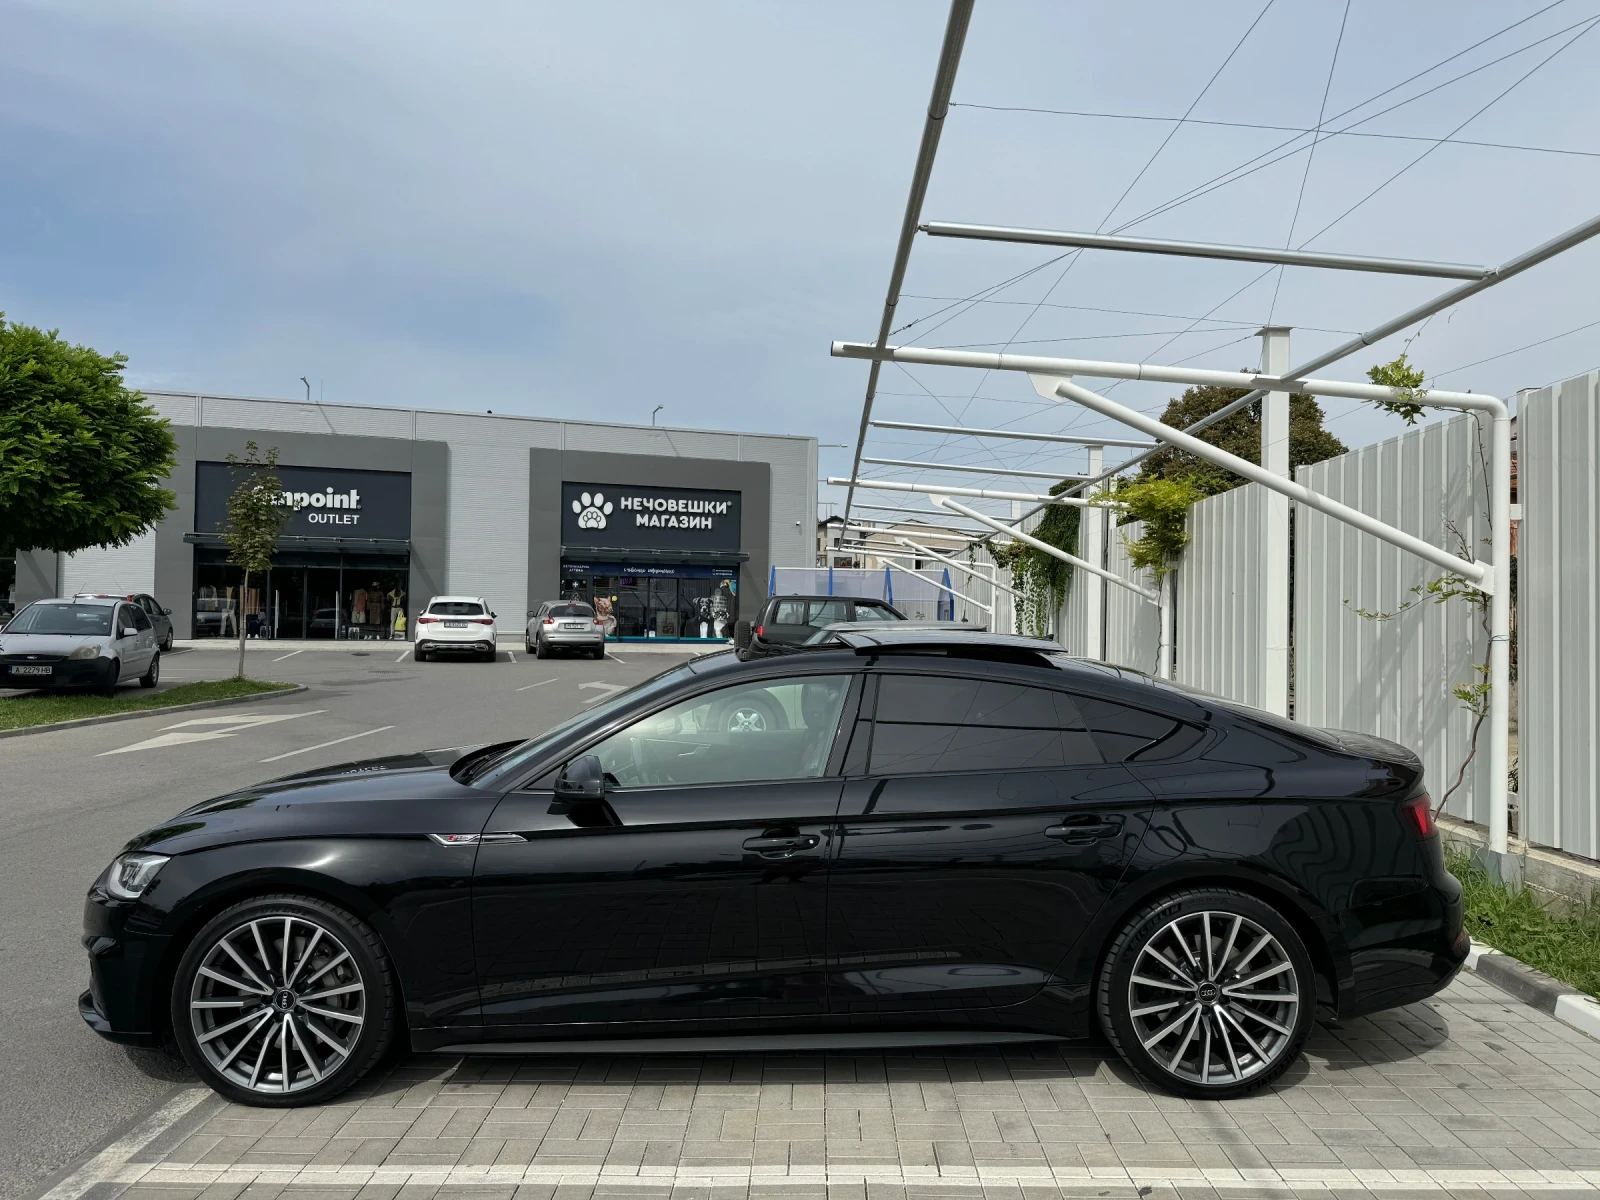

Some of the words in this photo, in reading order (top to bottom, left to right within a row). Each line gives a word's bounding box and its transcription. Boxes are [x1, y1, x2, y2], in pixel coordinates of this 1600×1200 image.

[620, 496, 727, 515] НЕЧОВЕШКИ
[308, 513, 360, 525] OUTLET
[636, 513, 712, 530] МАГАЗИН
[1130, 903, 1181, 949] MICHELIN
